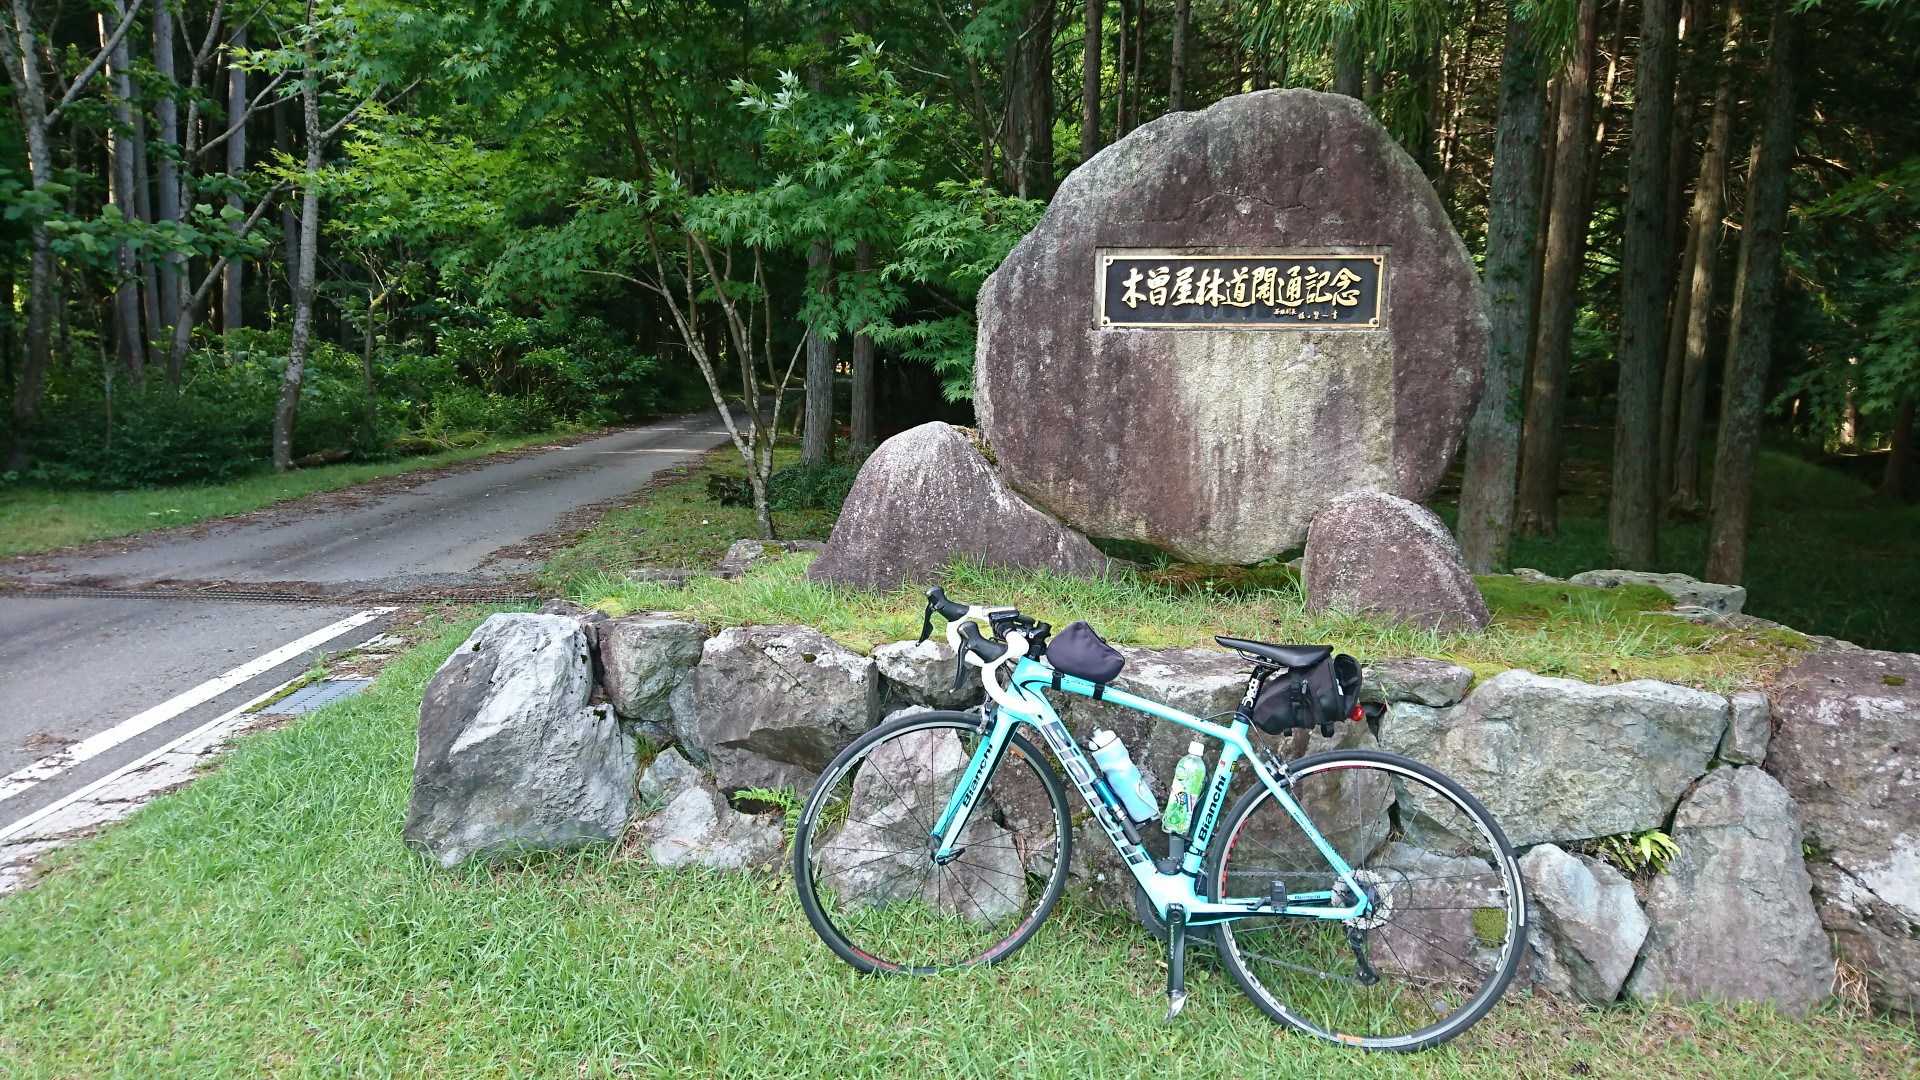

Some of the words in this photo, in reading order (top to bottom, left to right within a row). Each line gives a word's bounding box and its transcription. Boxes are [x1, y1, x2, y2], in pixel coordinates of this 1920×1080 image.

[1122, 266, 1361, 308] 木曽屋林道開通記念
[963, 744, 993, 808] Bianchi
[1042, 721, 1149, 865] Bianchi
[1198, 776, 1226, 842] Bianchi
[1225, 921, 1285, 1012] NEUTRO
